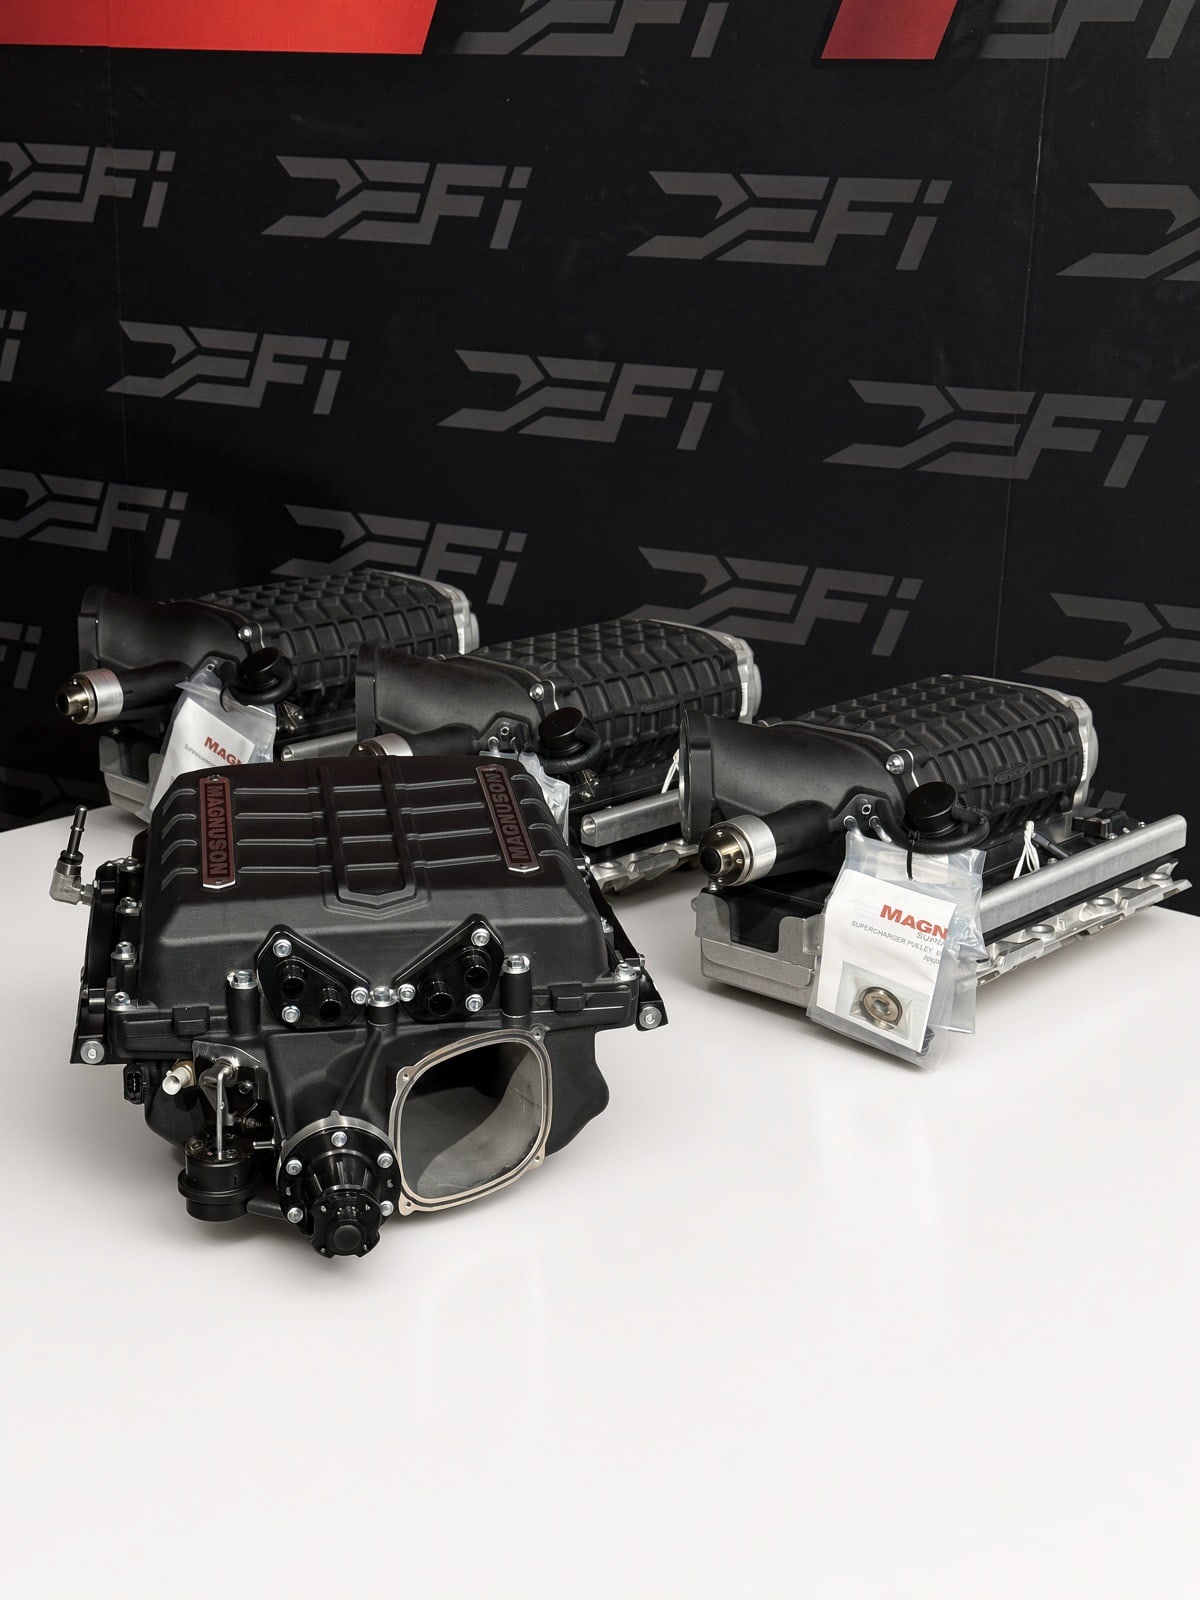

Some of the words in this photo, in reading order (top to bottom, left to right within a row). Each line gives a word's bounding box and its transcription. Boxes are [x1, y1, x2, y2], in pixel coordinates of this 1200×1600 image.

[204, 736, 242, 766] MAG
[207, 783, 228, 875] MAGNUSON
[485, 771, 530, 861] MAGNUSON
[850, 920, 906, 945] SUPERCHARGER
